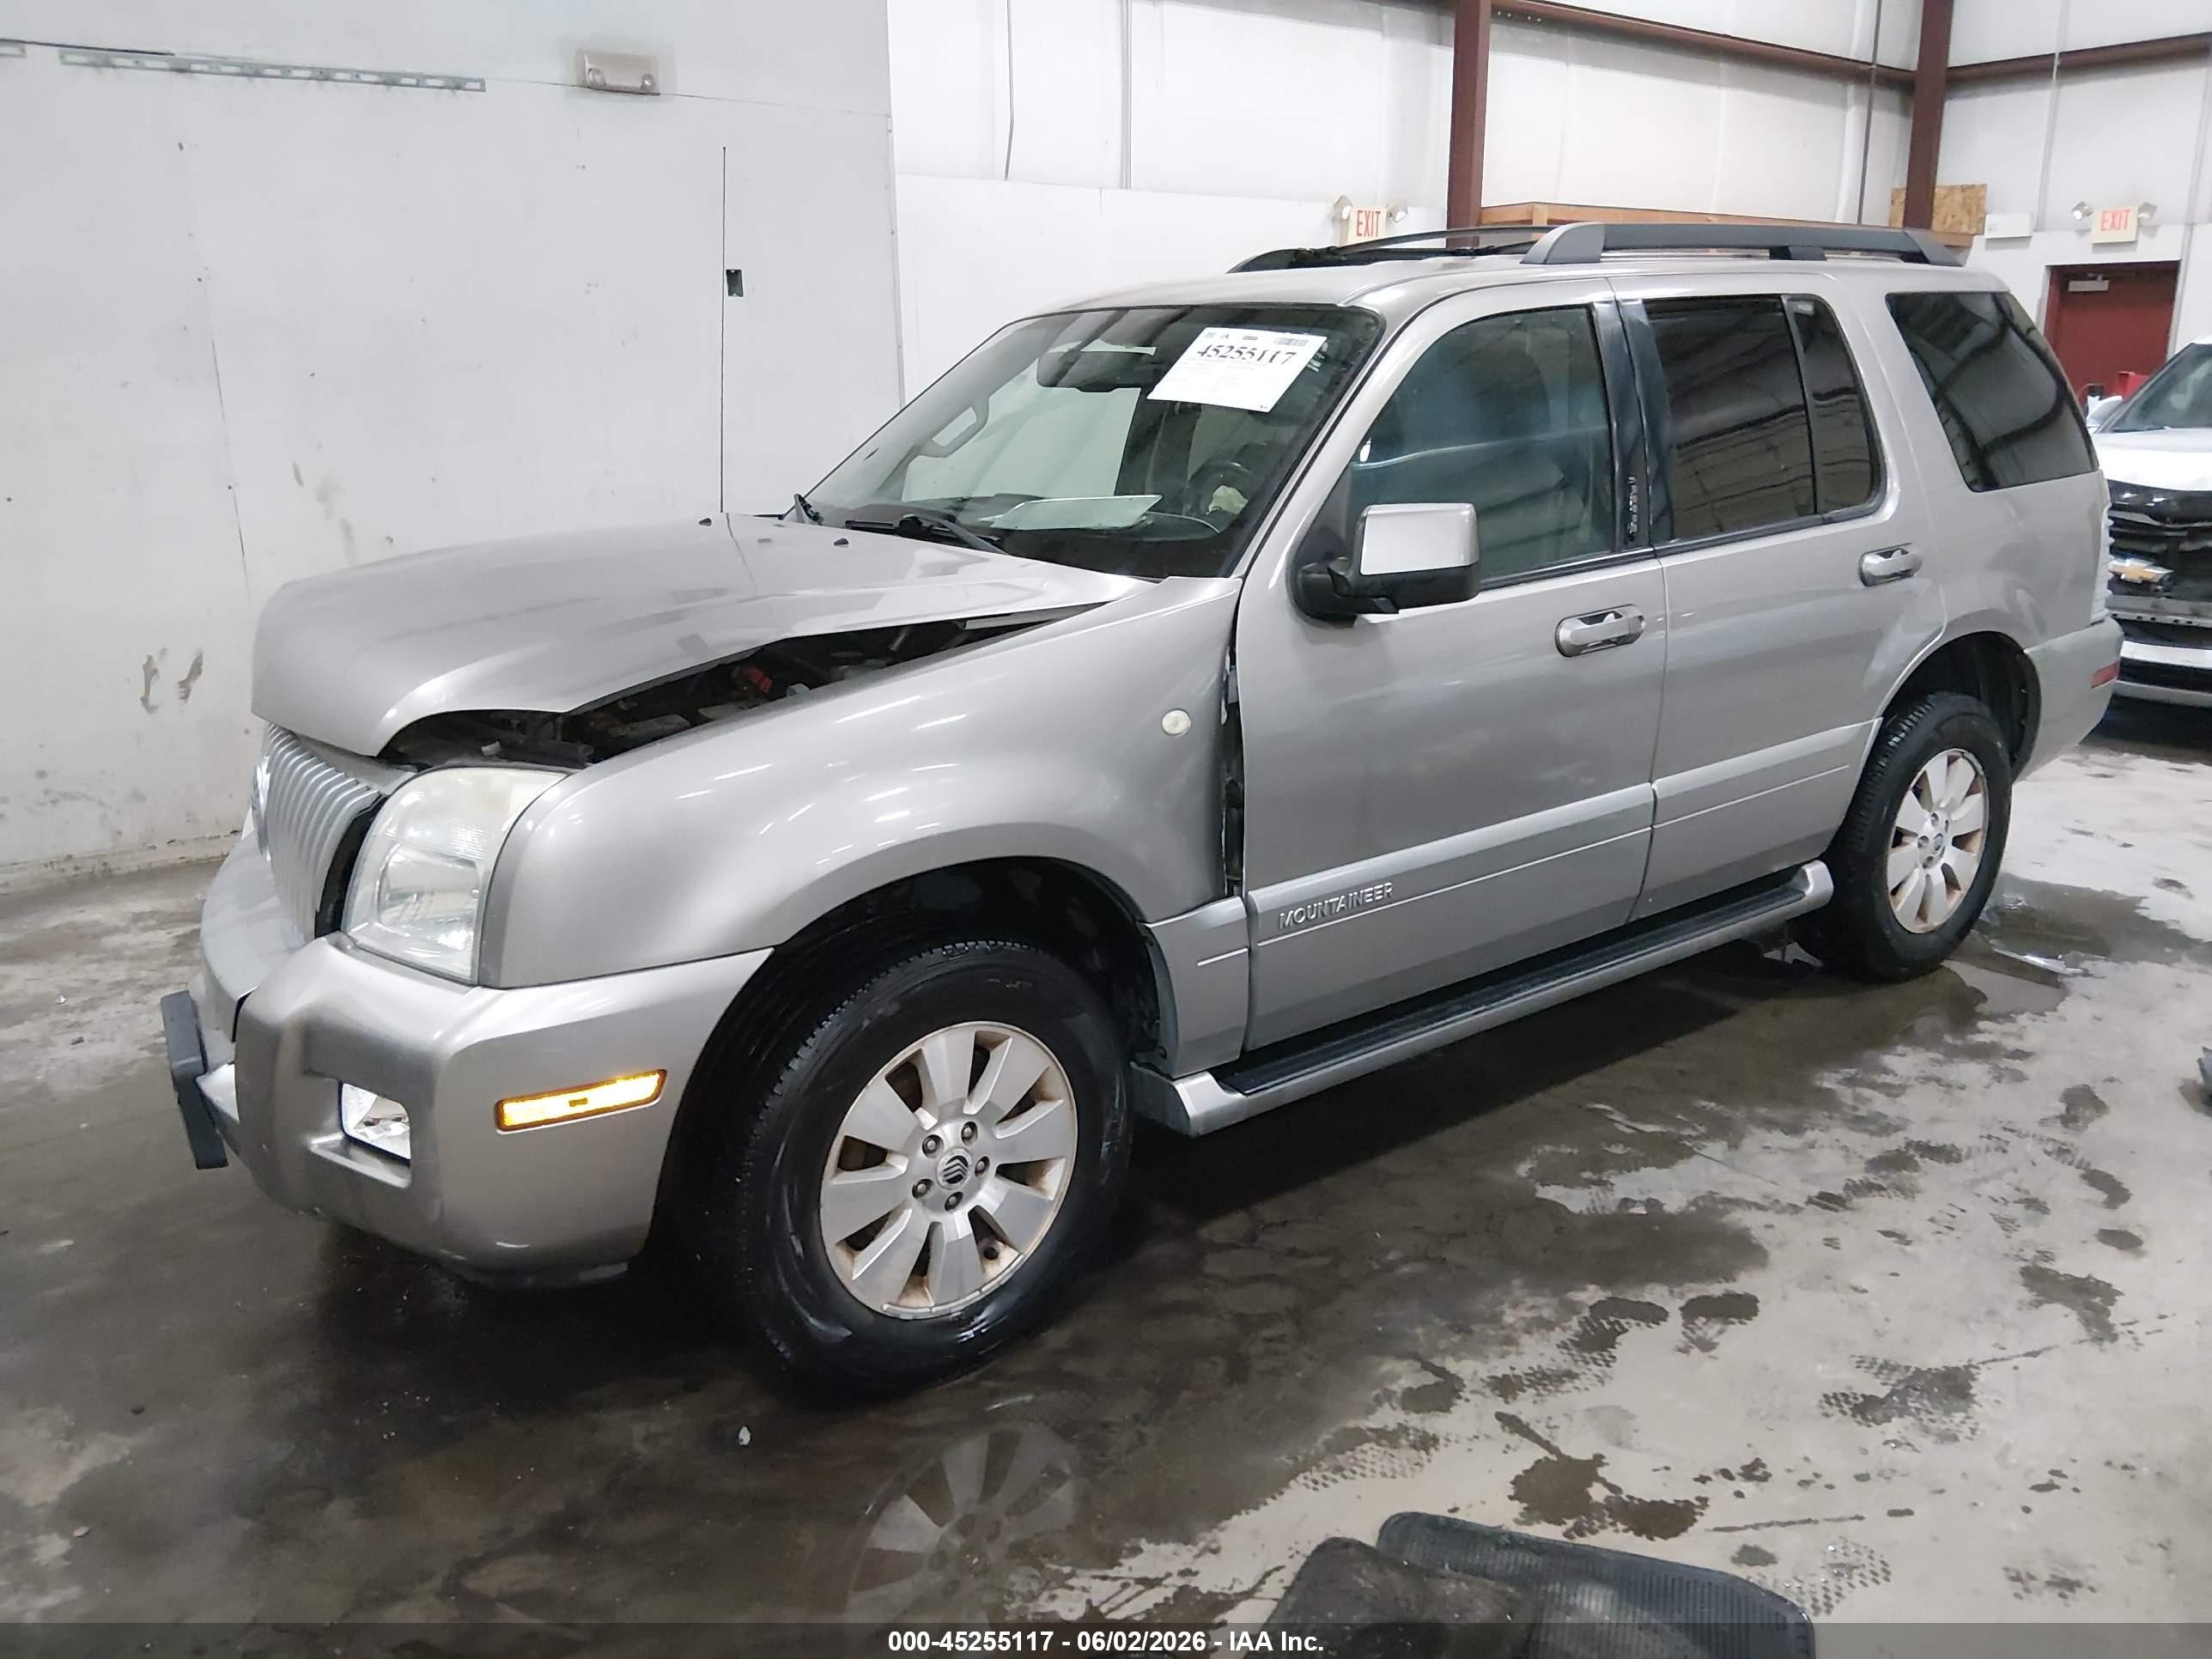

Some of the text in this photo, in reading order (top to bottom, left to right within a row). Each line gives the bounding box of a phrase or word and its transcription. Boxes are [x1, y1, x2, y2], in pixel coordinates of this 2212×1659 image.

[1356, 210, 1381, 237] EXIT
[2100, 209, 2130, 232] EXIT
[1197, 343, 1297, 365] 45255117
[1278, 882, 1394, 929] MOUNTAINEER
